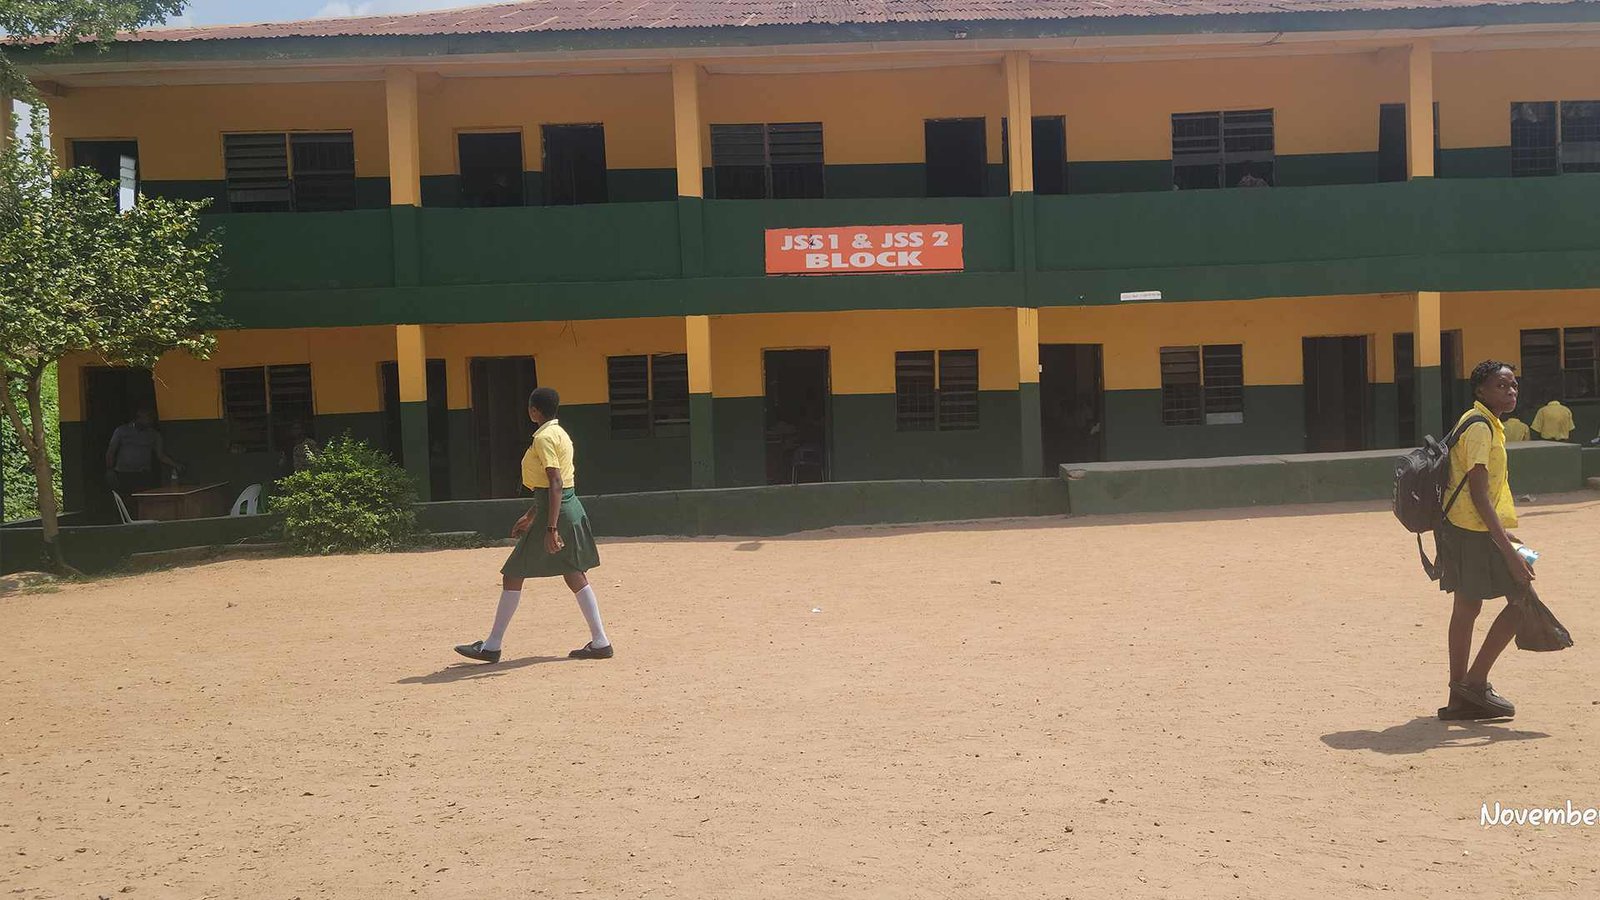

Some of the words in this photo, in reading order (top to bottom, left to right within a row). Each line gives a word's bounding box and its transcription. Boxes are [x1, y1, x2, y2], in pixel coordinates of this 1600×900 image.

[851, 233, 874, 249] &
[881, 231, 924, 249] JSS
[931, 230, 949, 247] 2
[805, 250, 923, 269] BLOCK
